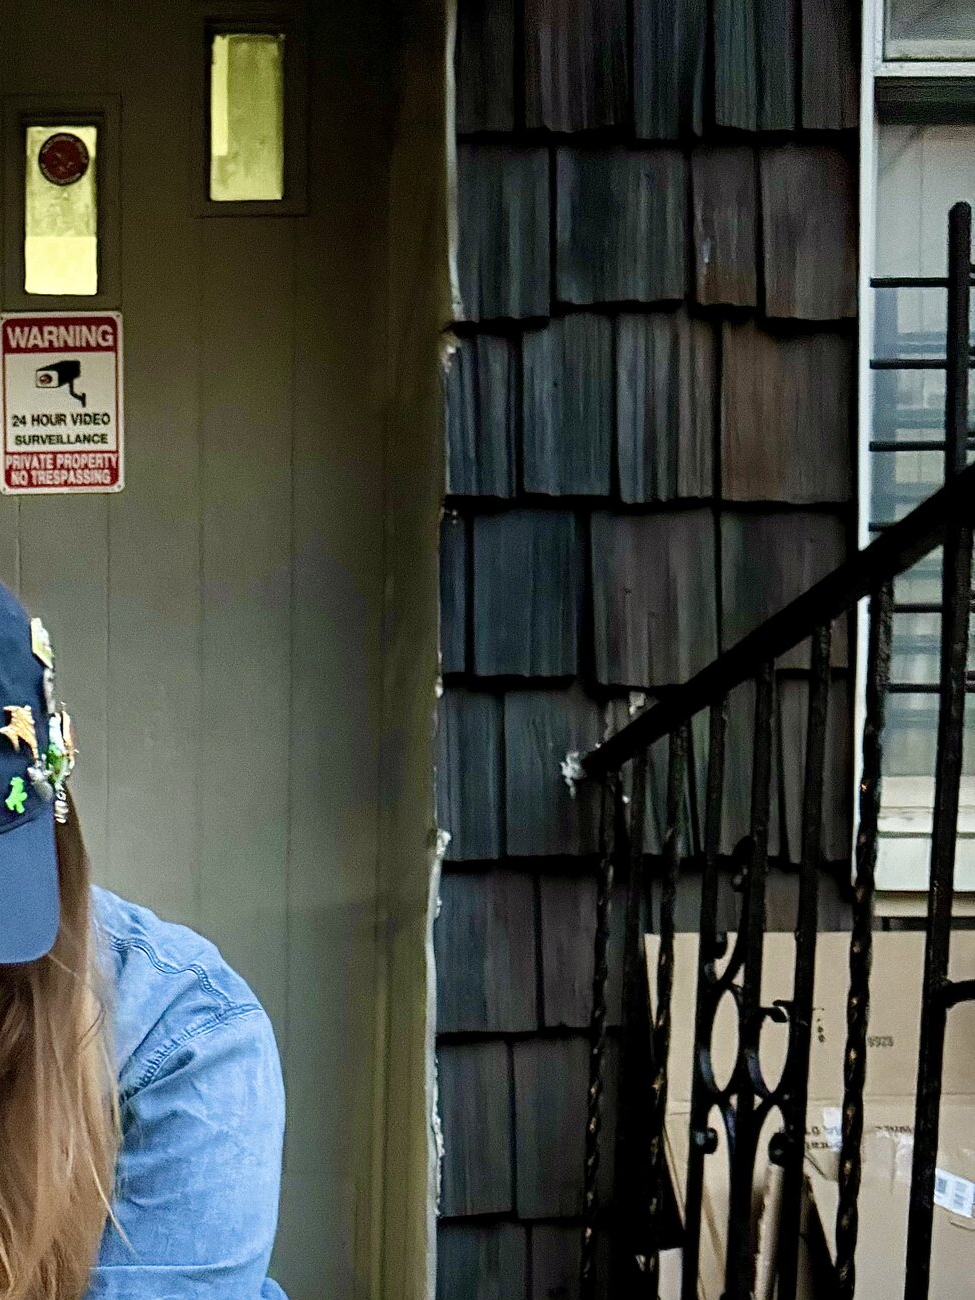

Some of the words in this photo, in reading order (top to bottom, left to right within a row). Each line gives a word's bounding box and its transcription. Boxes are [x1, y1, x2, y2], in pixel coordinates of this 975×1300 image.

[8, 325, 113, 348] WARNING
[12, 415, 26, 427] 24
[31, 413, 66, 426] HOUR
[71, 412, 111, 426] VIDEO
[15, 433, 108, 445] SURVEILLANCE
[6, 454, 53, 469] PRIVATE
[56, 453, 118, 469] PROPERTY
[10, 470, 28, 485] NO
[31, 469, 110, 485] TRESPASSING
